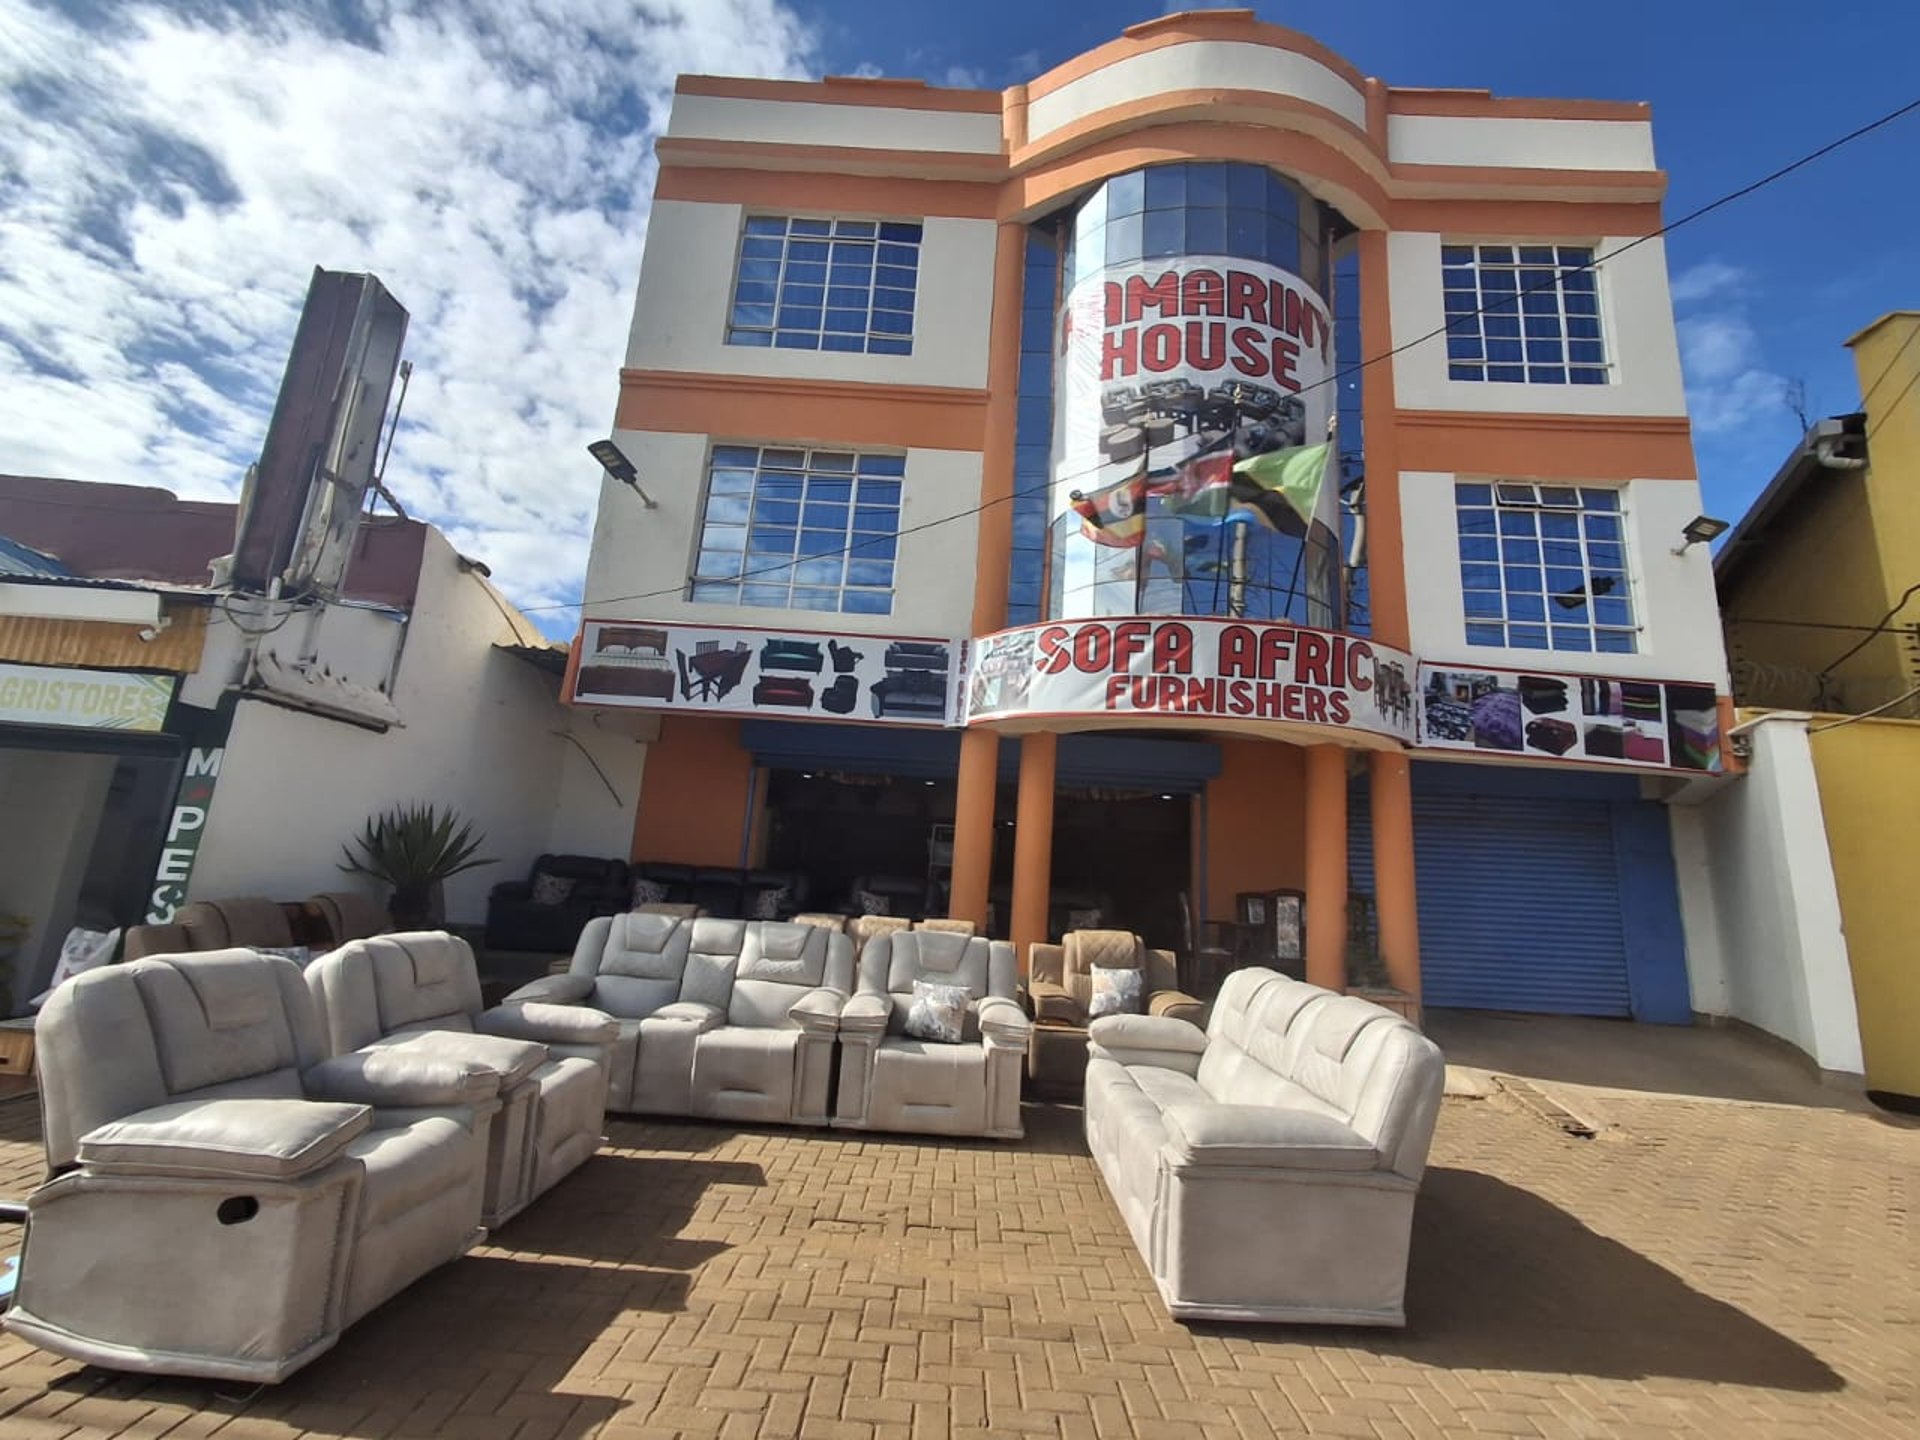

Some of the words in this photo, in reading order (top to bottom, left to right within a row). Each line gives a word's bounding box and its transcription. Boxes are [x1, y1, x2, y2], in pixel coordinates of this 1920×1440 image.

[1099, 321, 1301, 393] HOUSE
[1034, 622, 1193, 674] SOFA
[1218, 625, 1374, 692] AFRIC
[1105, 675, 1351, 724] FURNISHERS
